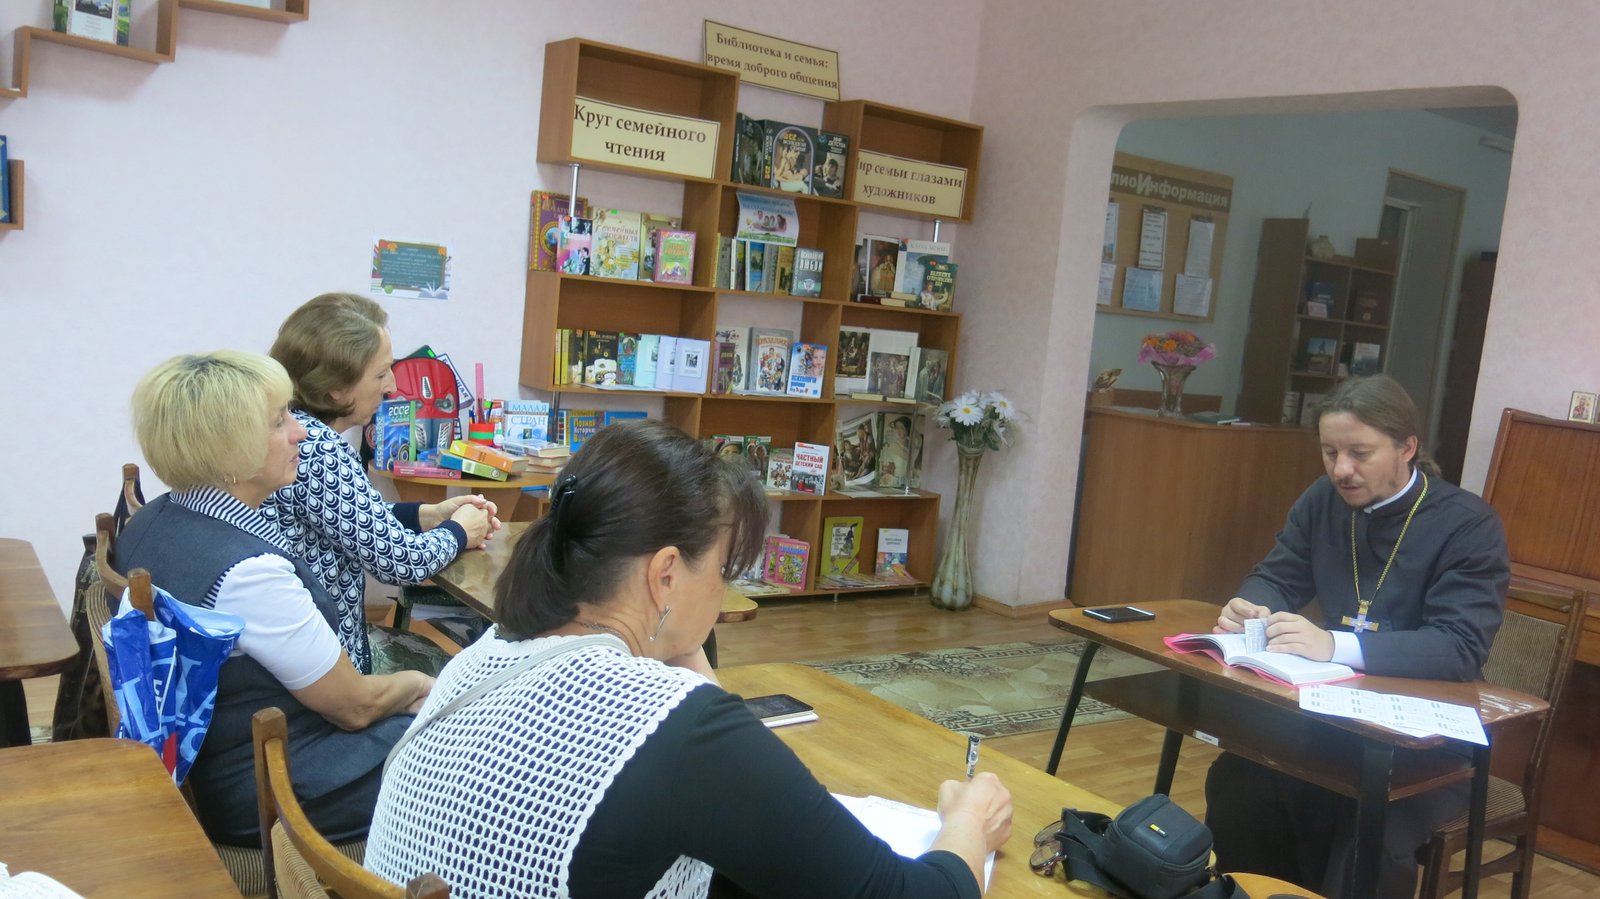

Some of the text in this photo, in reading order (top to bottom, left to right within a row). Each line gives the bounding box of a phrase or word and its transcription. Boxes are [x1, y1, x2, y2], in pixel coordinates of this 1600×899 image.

[716, 32, 829, 68] Библиотека и семья:
[707, 53, 838, 89] время доброго общения
[574, 104, 706, 143] Круг семейного
[605, 141, 666, 162] чтения
[874, 164, 907, 179] семьи
[911, 171, 963, 188] глазами
[862, 184, 936, 205] художников
[388, 405, 410, 417] 2002
[512, 404, 547, 413] МАЛАЯ
[511, 416, 546, 426] СТРАН
[796, 453, 824, 464] ЧАСТНЫЙ
